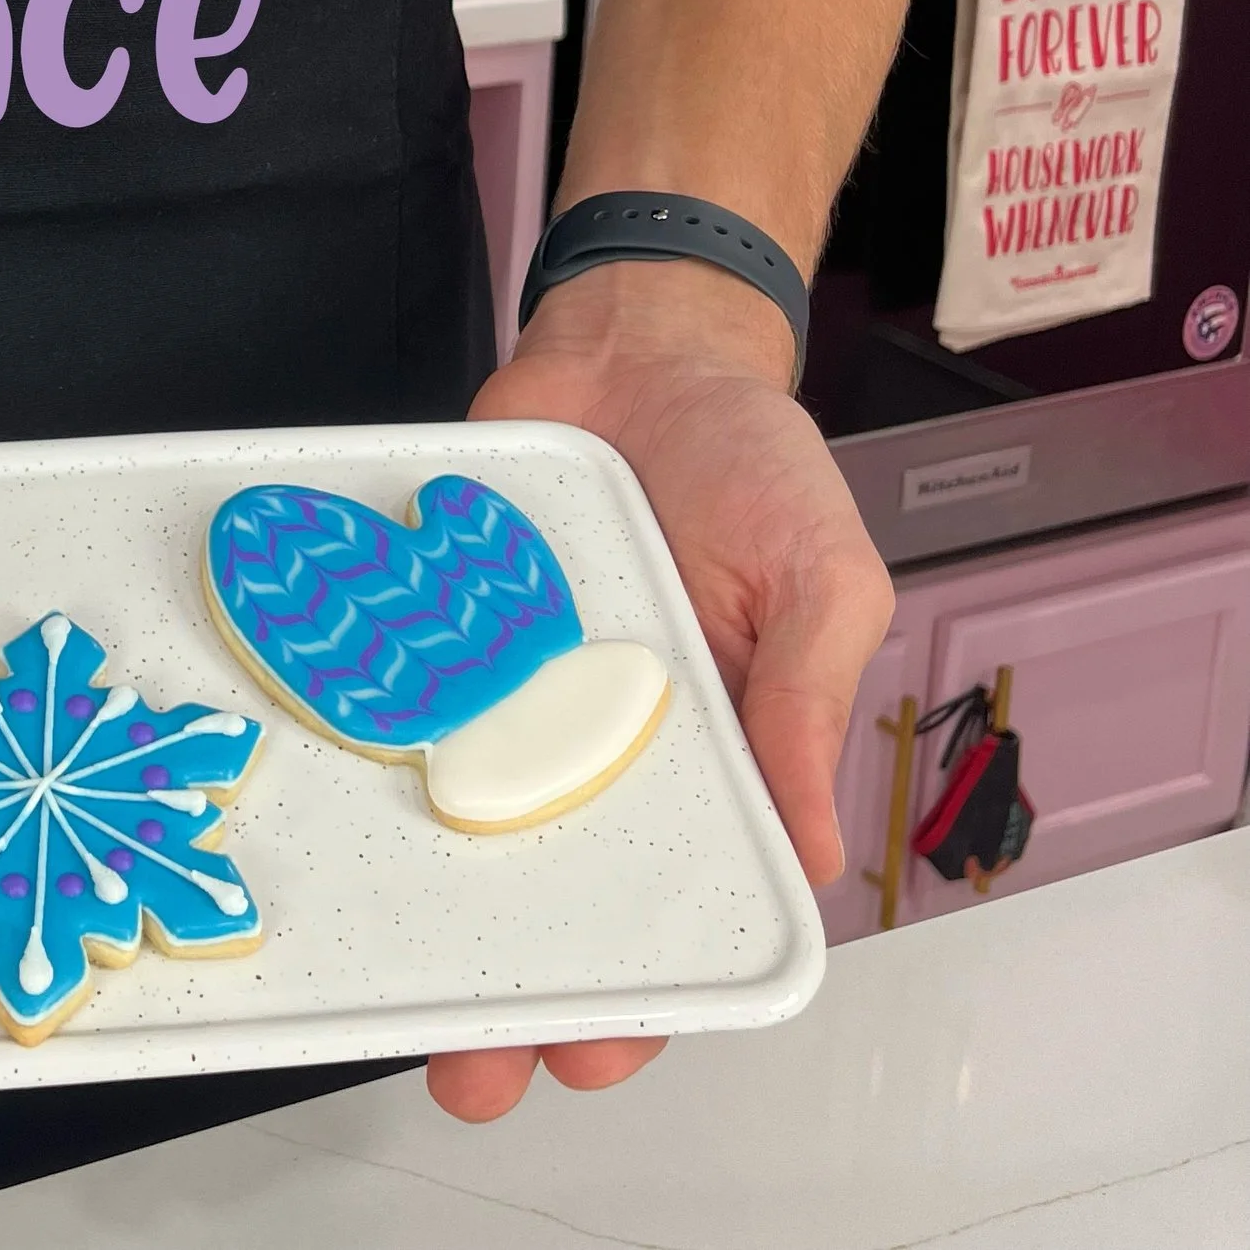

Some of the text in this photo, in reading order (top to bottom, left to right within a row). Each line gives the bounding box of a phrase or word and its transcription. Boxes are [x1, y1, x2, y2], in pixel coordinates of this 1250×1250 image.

[998, 0, 1161, 83] FOREVER
[986, 128, 1144, 197] HOUSEWORK
[984, 184, 1138, 259] WHENEVER
